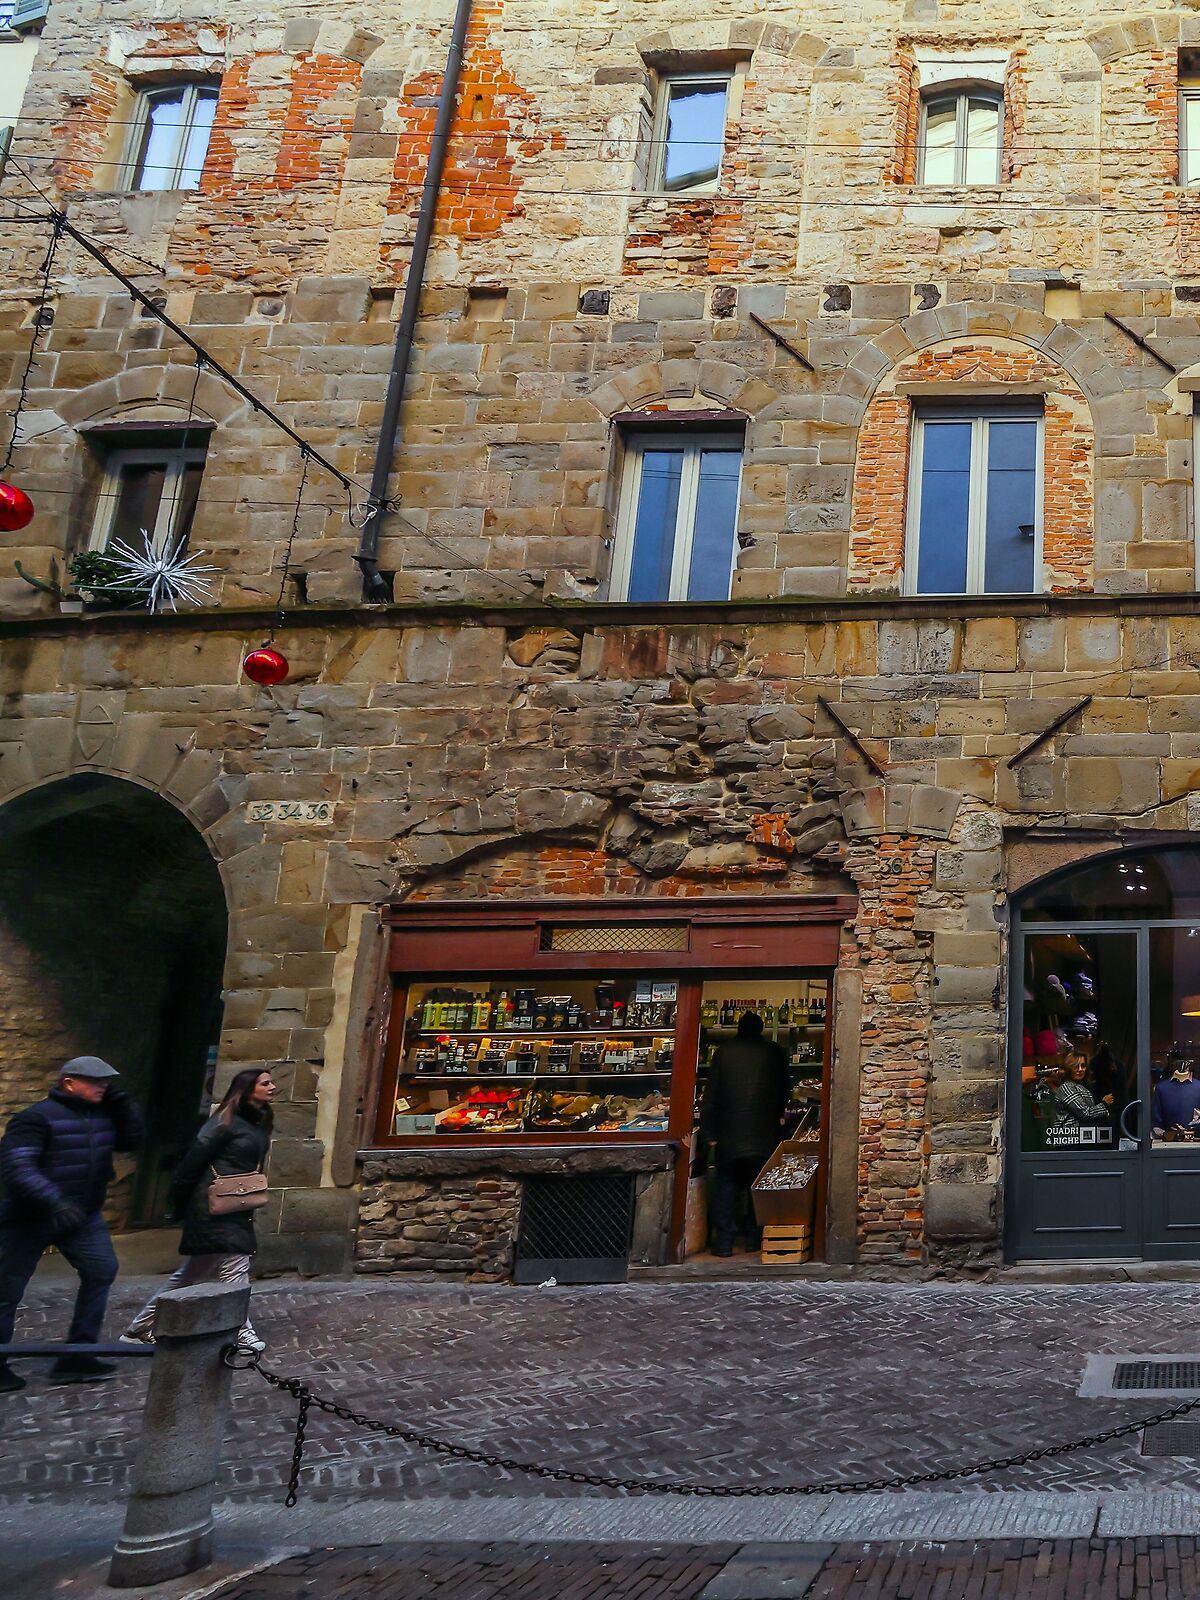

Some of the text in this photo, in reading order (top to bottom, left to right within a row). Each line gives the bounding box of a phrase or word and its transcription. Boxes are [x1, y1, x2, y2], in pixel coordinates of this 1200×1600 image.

[306, 803, 329, 820] 36
[1045, 1127, 1079, 1136] QUADRI
[1045, 1136, 1080, 1145] & RIGHE
